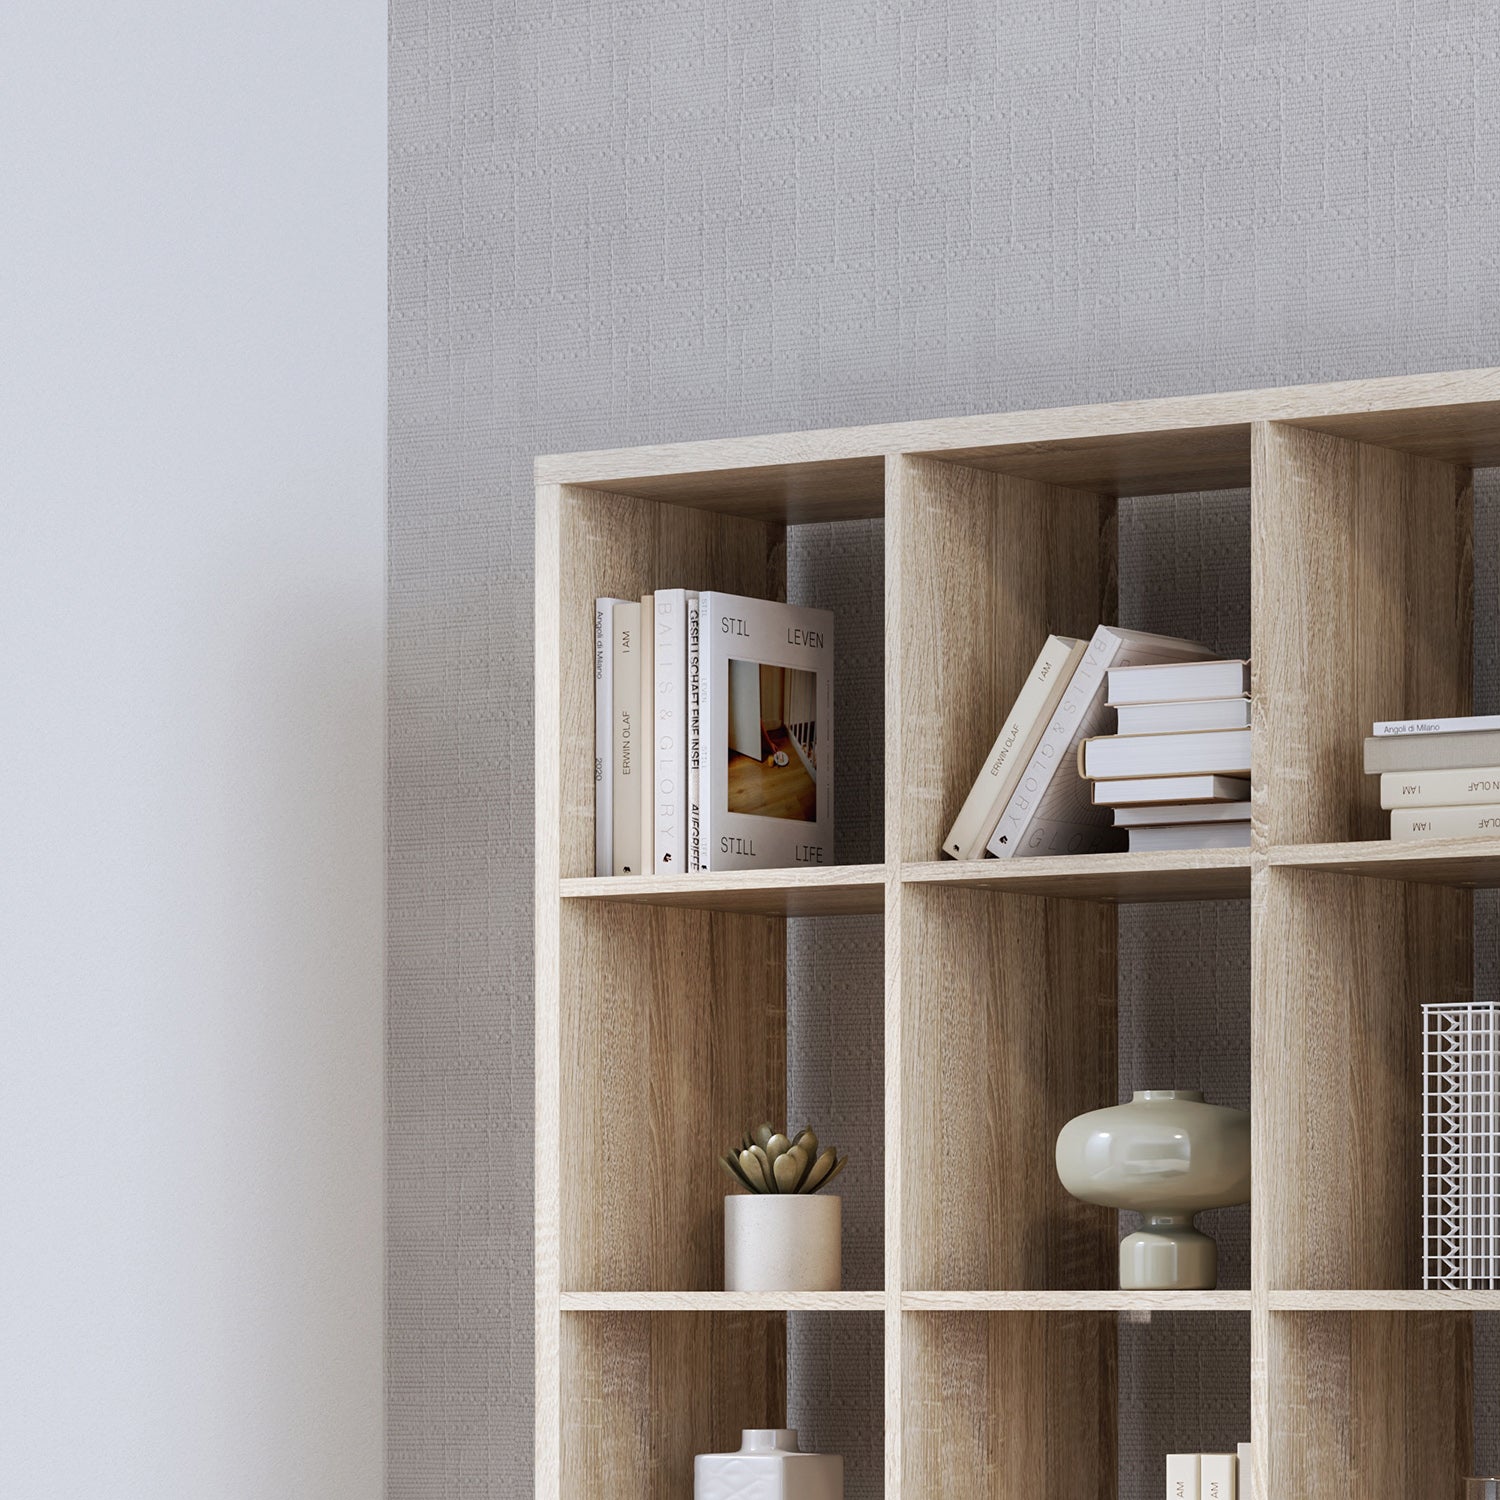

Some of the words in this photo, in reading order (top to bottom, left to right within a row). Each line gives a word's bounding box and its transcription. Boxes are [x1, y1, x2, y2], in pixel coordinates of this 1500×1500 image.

[623, 631, 630, 648] AM
[721, 616, 750, 637] STIL
[787, 628, 824, 649] LEVEN
[1039, 661, 1052, 678] AM
[622, 711, 631, 739] OLAF
[1384, 723, 1406, 735] Angoli
[1408, 724, 1415, 732] di
[1416, 723, 1440, 731] Milano
[622, 740, 631, 775] ERWIN
[990, 746, 1009, 777] ERWIN
[1004, 724, 1020, 751] OLAF
[659, 735, 675, 838] GLORY
[1402, 786, 1416, 795] AM
[1468, 781, 1491, 791] OLAF
[1412, 822, 1427, 832] AM
[1478, 818, 1500, 829] OLAF
[720, 836, 756, 856] STILL
[795, 846, 823, 863] LIFE
[1177, 1481, 1184, 1499] AM
[1211, 1482, 1218, 1499] AM
